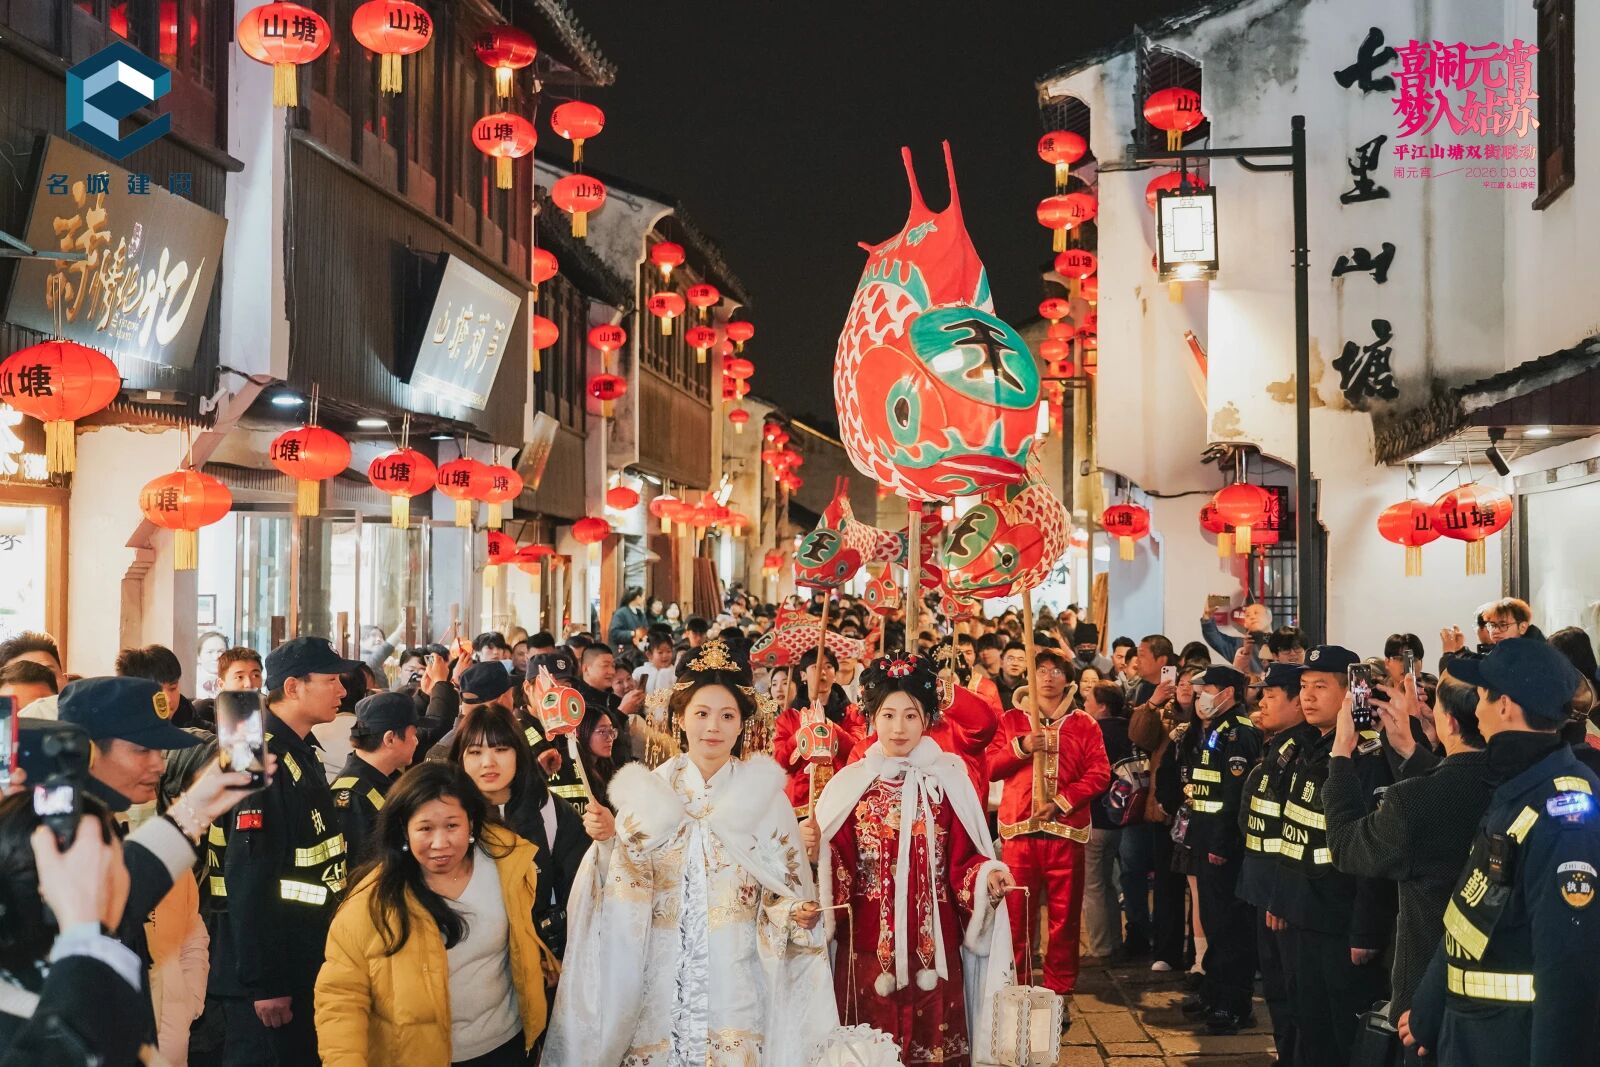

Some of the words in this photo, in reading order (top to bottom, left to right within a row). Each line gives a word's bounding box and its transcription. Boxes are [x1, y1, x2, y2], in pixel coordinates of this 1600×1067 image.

[263, 15, 318, 42] 山塘
[388, 9, 430, 37] 山塘
[477, 122, 513, 142] 山塘
[1332, 27, 1399, 399] 七里山塘
[1068, 255, 1093, 268] 山塘
[599, 332, 622, 344] 山塘
[373, 462, 411, 483] 山塘
[437, 468, 471, 488] 山塘
[1105, 511, 1133, 527] 山塘
[1446, 504, 1496, 529] 山塘
